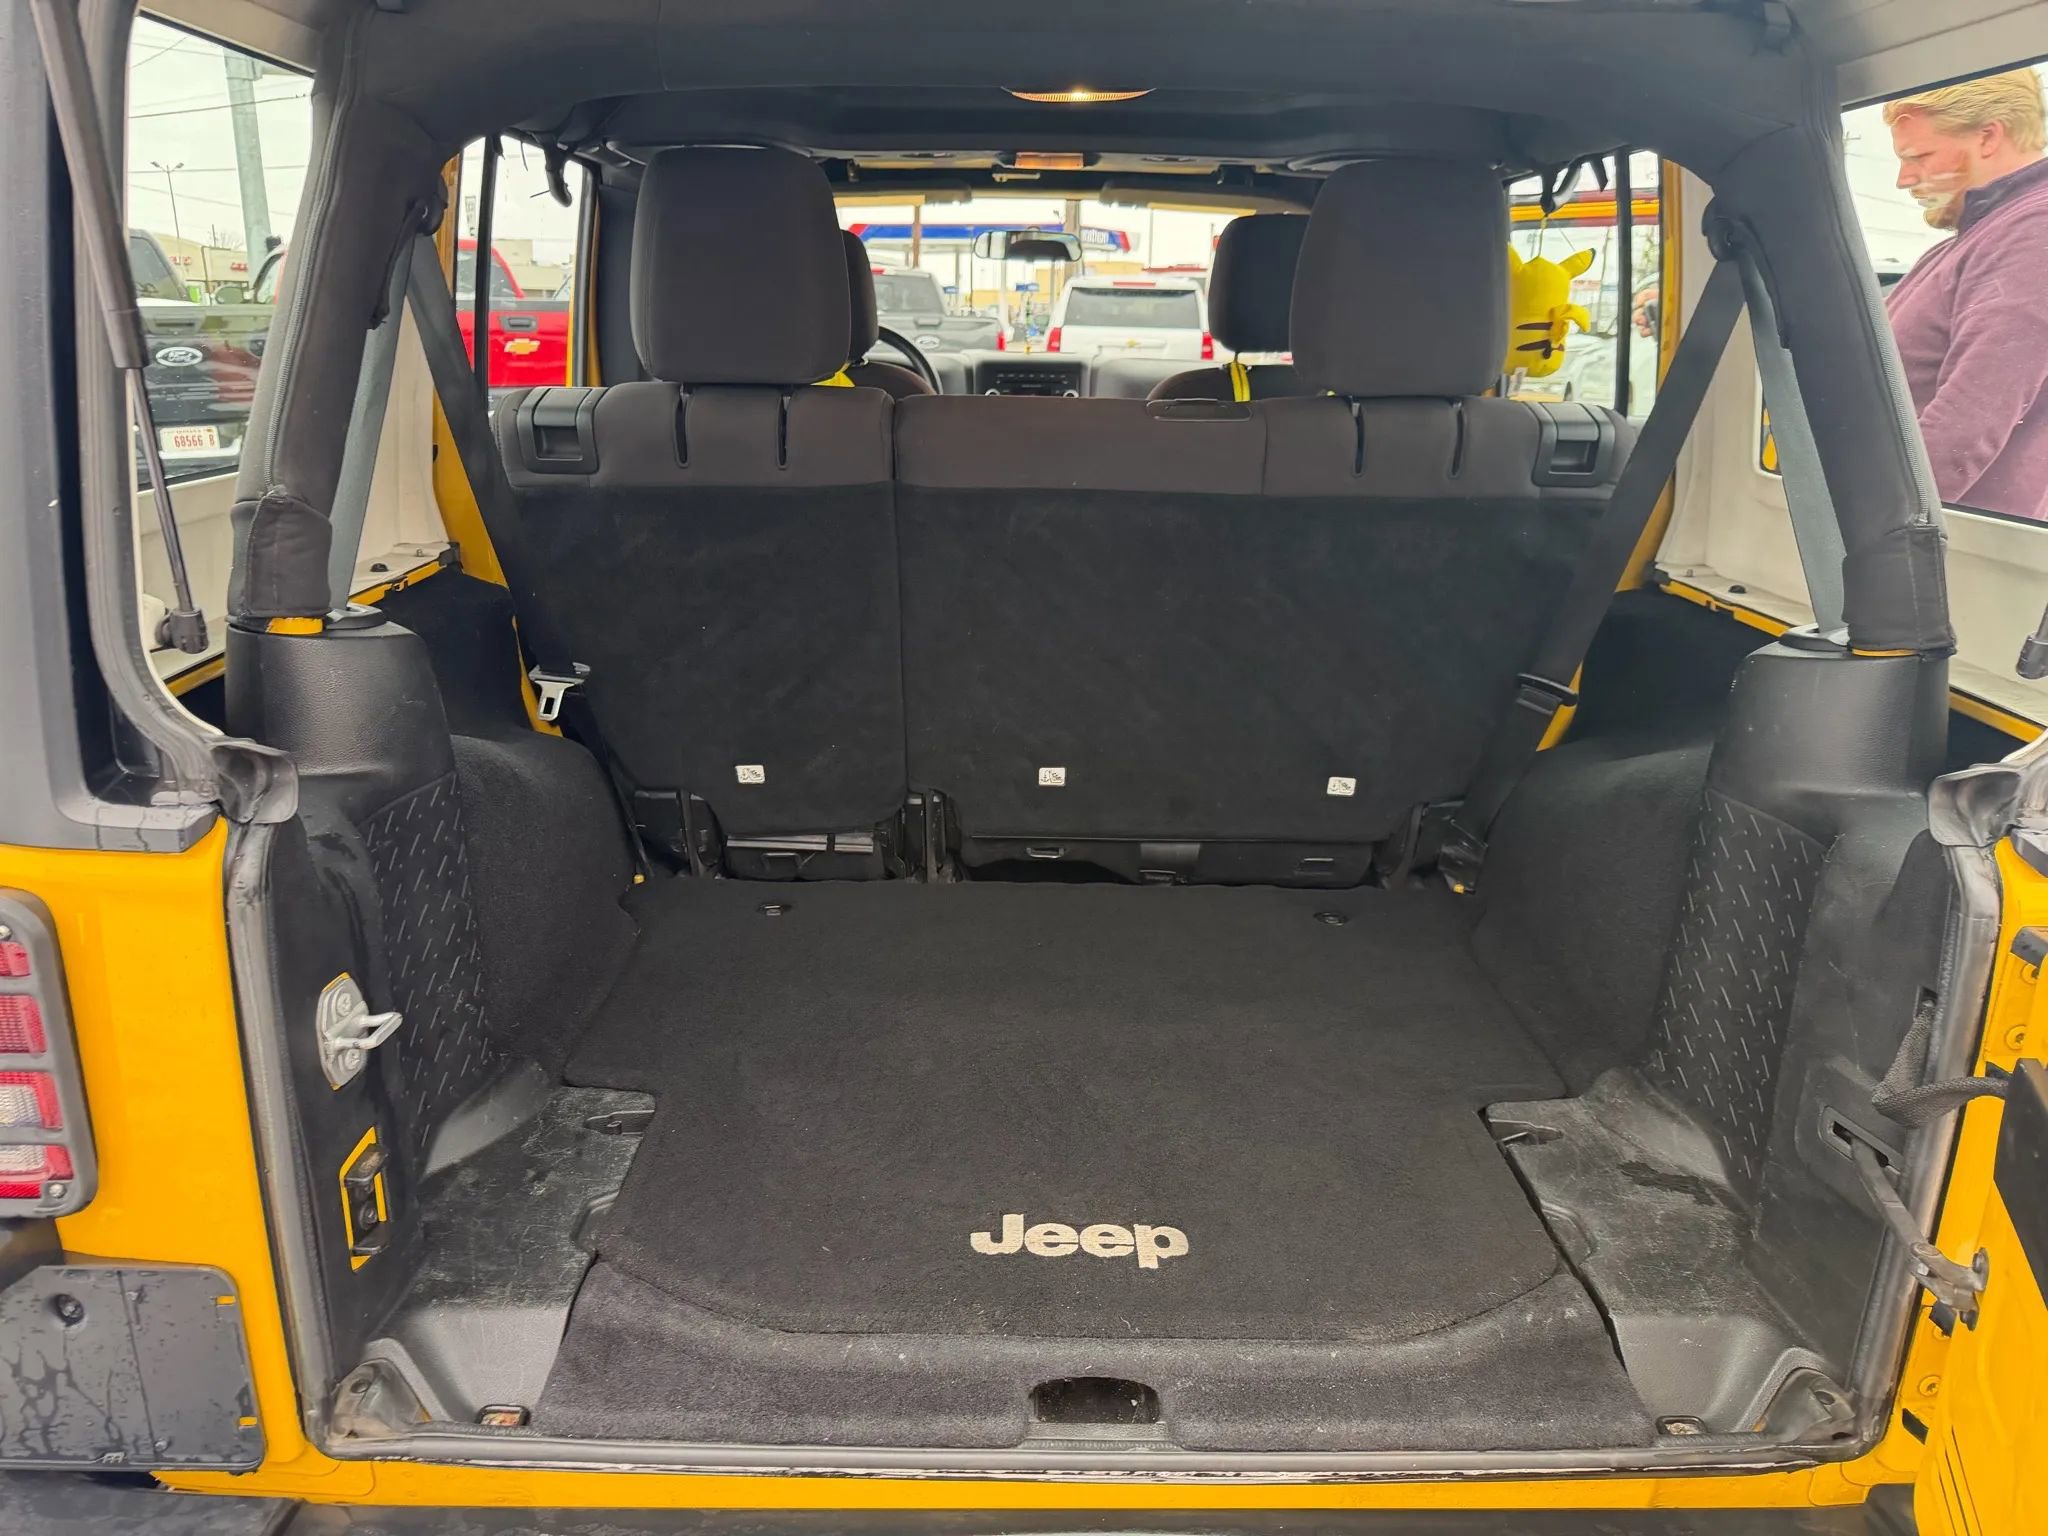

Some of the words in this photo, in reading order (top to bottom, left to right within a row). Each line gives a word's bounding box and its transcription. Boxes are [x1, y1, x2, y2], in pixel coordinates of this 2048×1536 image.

[174, 434, 204, 448] 68566
[208, 433, 215, 447] B
[970, 1213, 1189, 1268] Jeep
